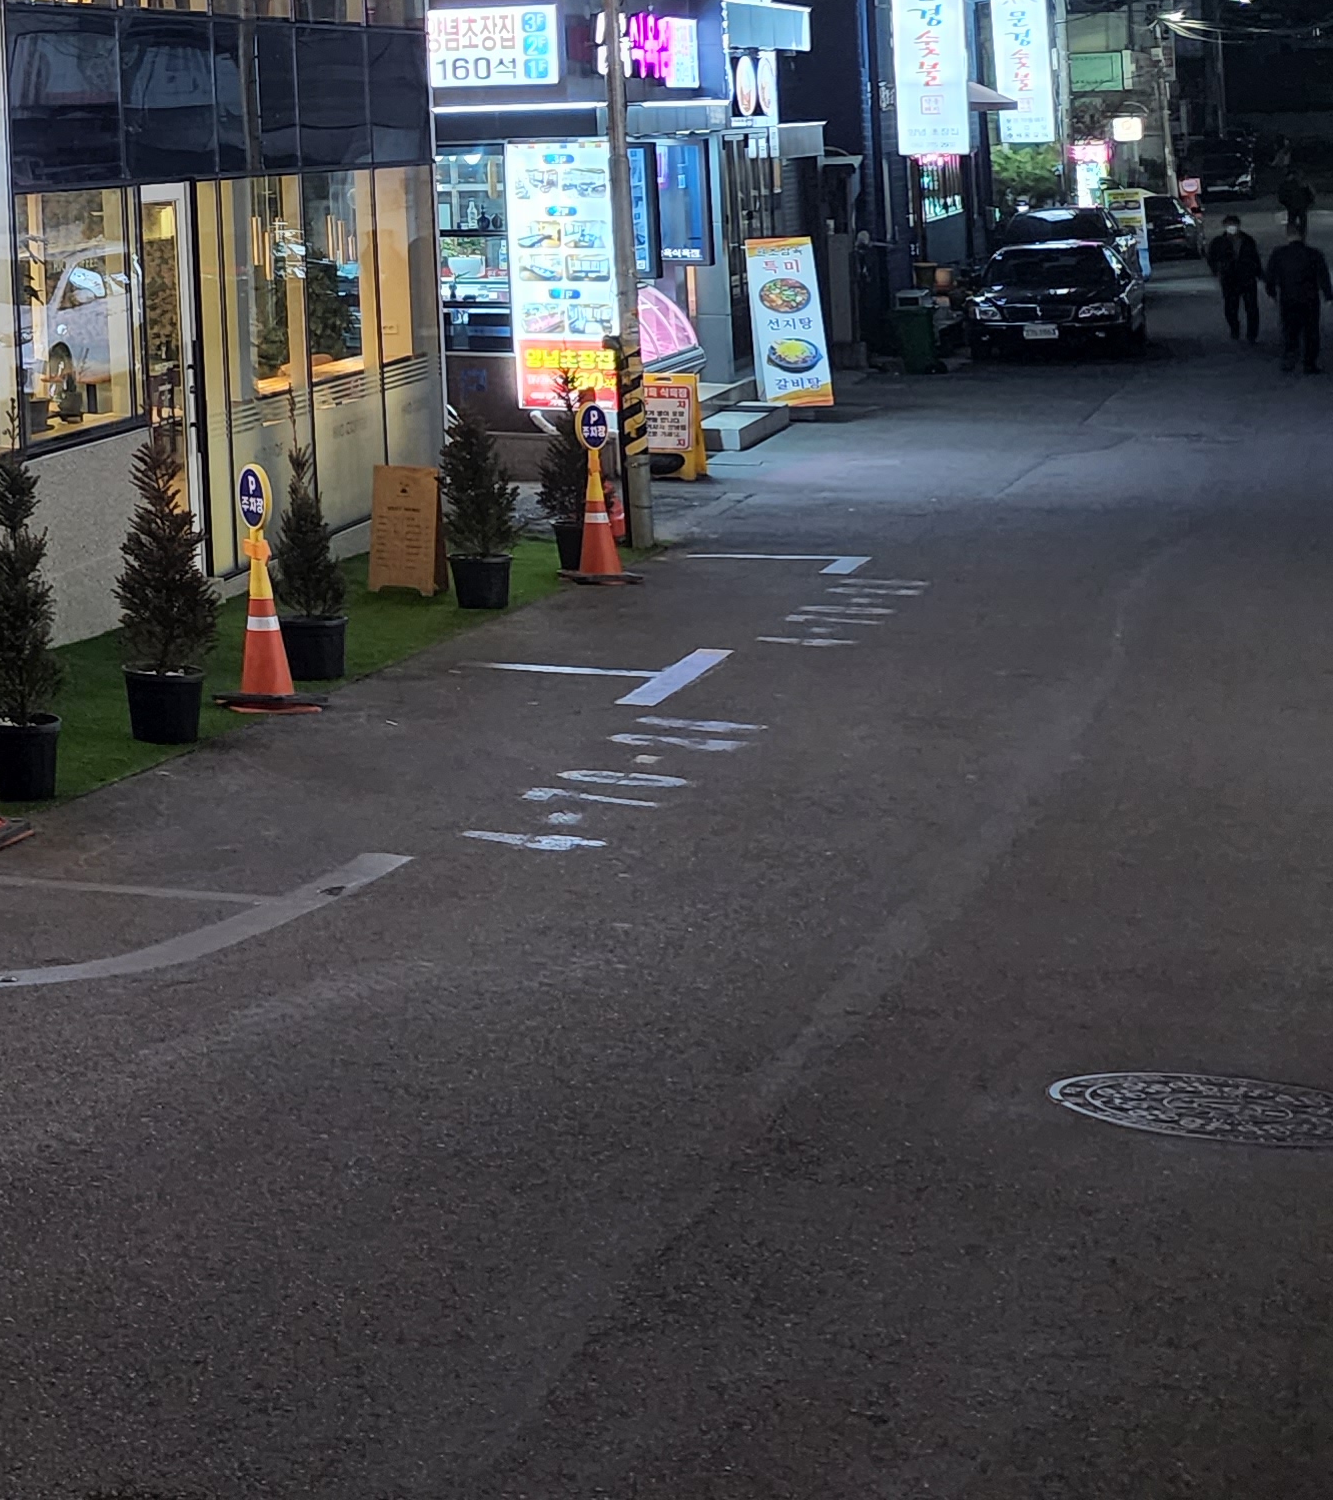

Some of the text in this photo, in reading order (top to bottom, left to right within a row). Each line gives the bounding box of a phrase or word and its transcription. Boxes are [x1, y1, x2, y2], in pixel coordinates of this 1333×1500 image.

[428, 14, 516, 53] 양념초장집
[436, 57, 516, 80] 160석
[661, 248, 701, 259] 육식육점
[767, 316, 814, 331] 선지탕
[775, 376, 823, 392] 갈비탕
[589, 409, 599, 424] P
[582, 425, 606, 438] 주차장
[247, 475, 256, 494] P
[241, 496, 263, 514] 주차장
